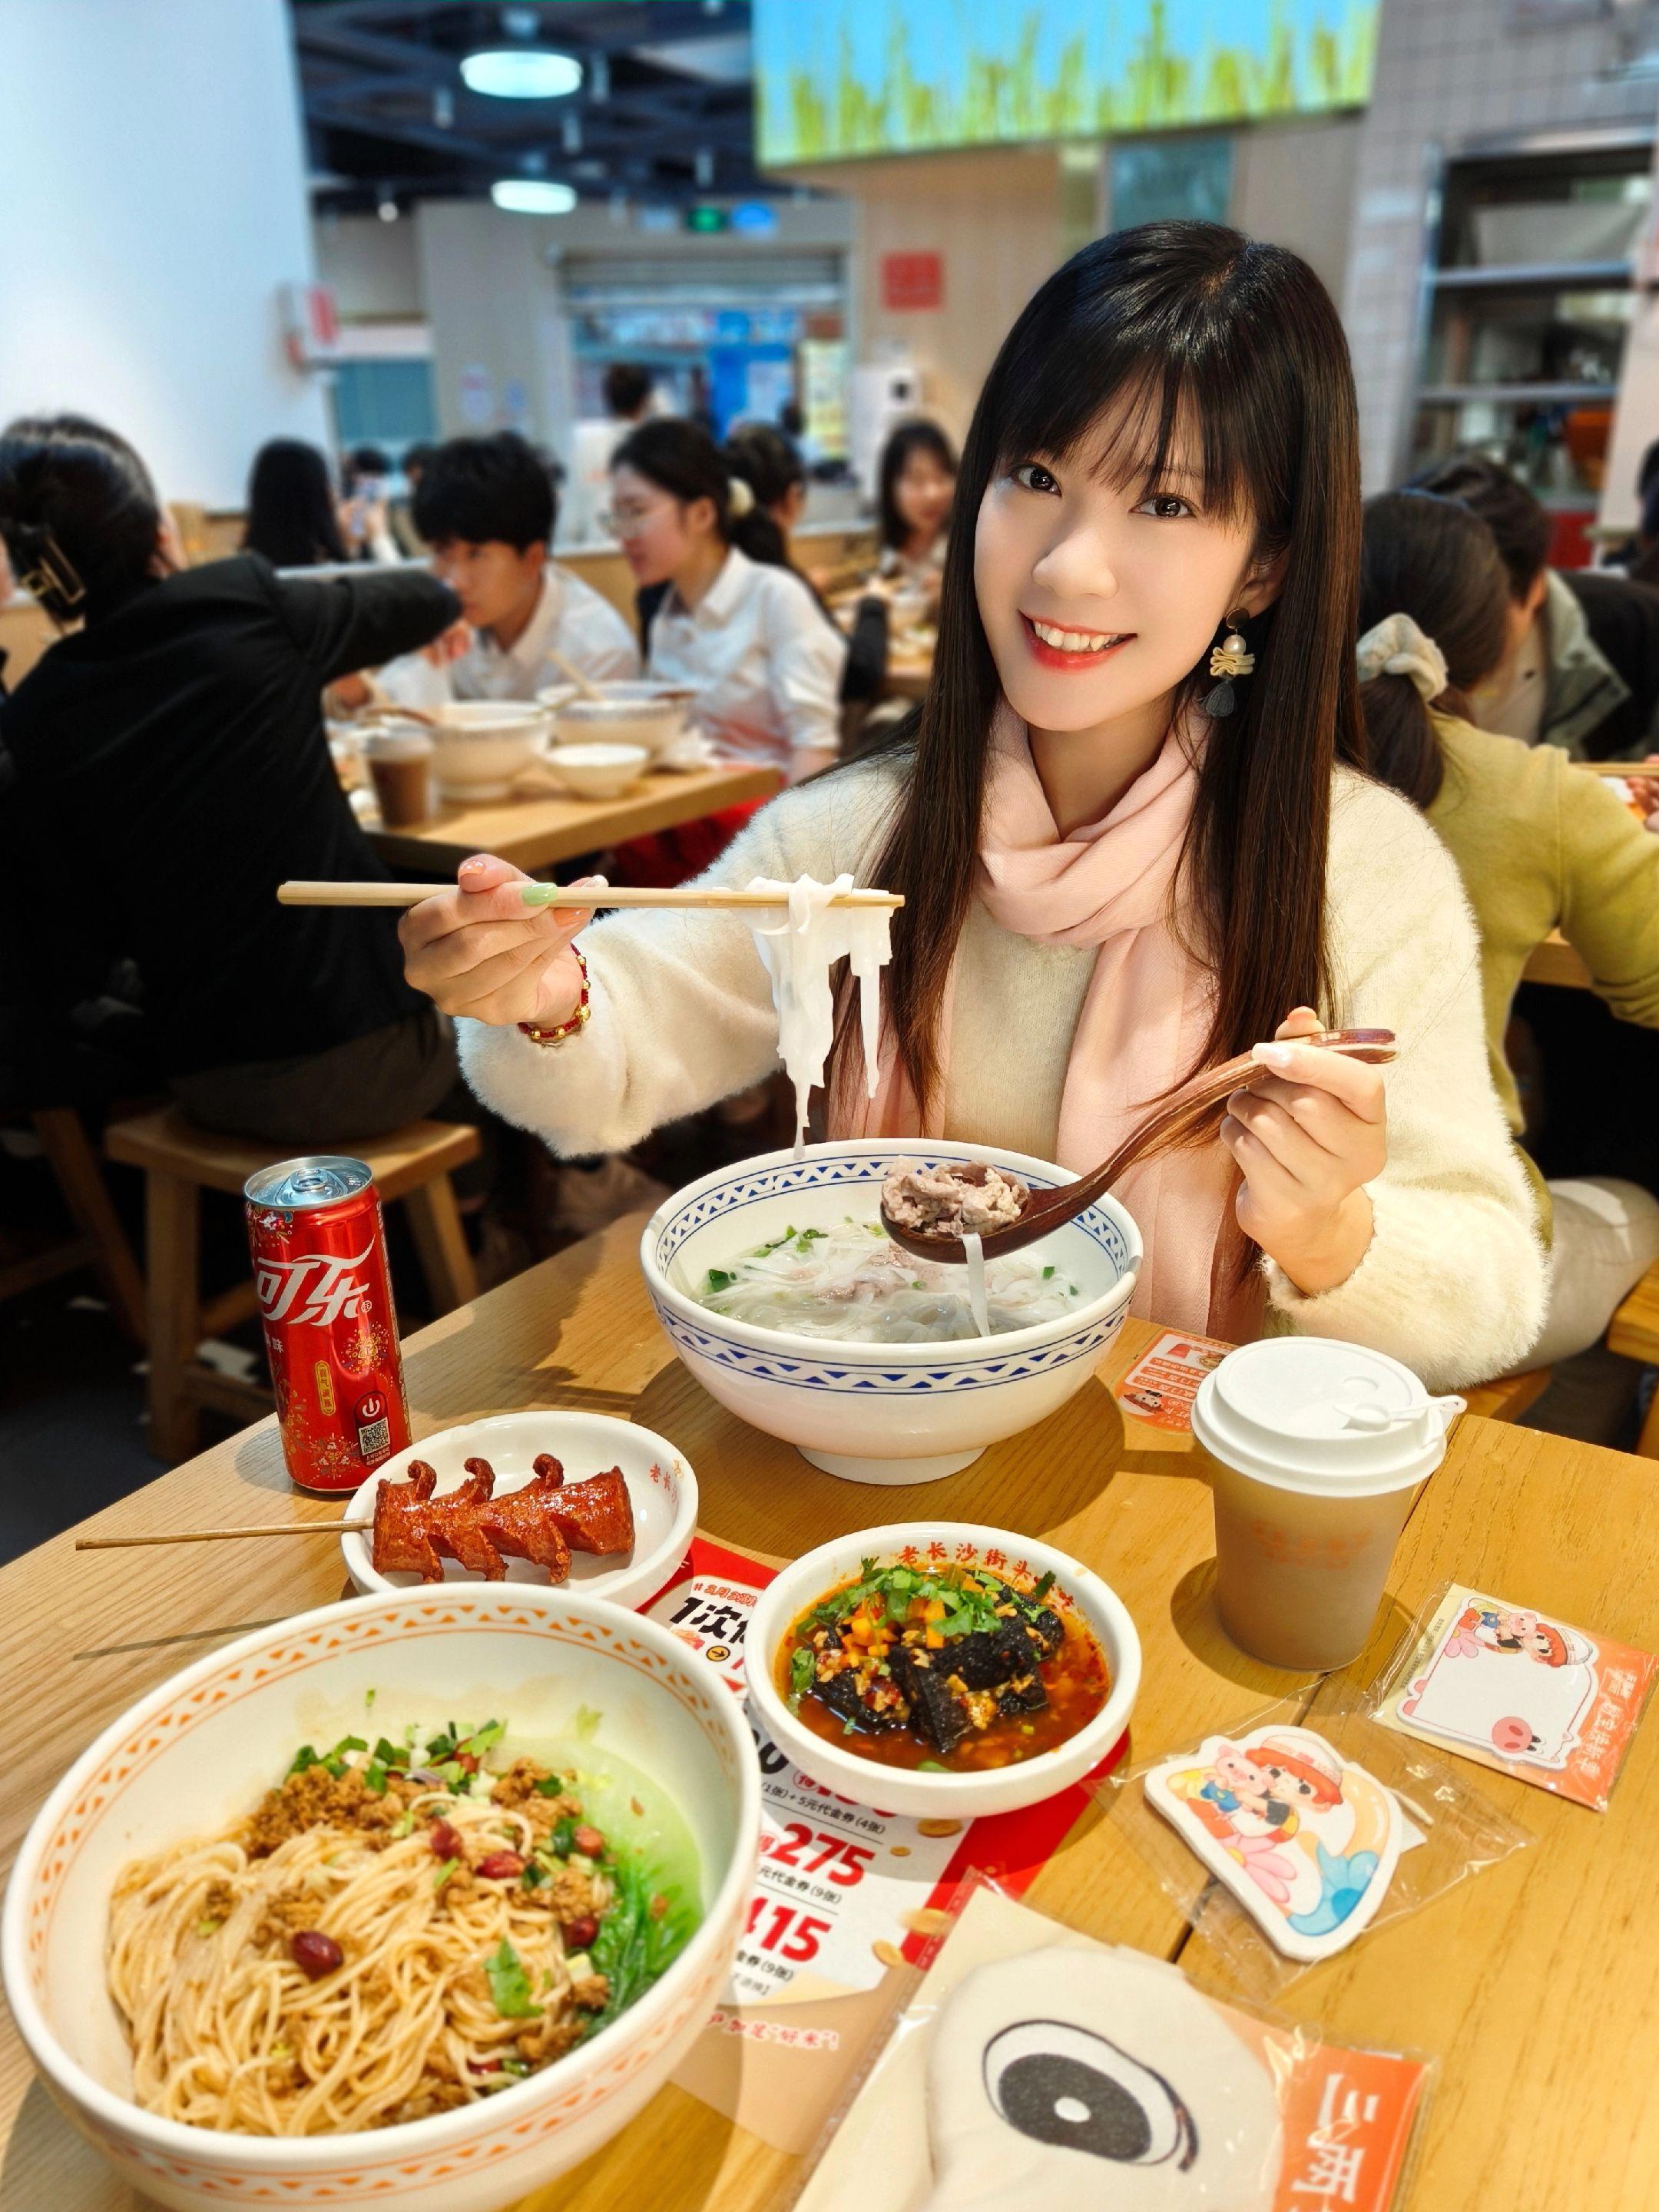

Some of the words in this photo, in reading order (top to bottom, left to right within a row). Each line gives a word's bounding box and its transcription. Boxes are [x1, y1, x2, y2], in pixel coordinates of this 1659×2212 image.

[257, 1233, 376, 1326] 可乐
[768, 1823, 876, 1887] 275
[1290, 2073, 1380, 2212] 三两
